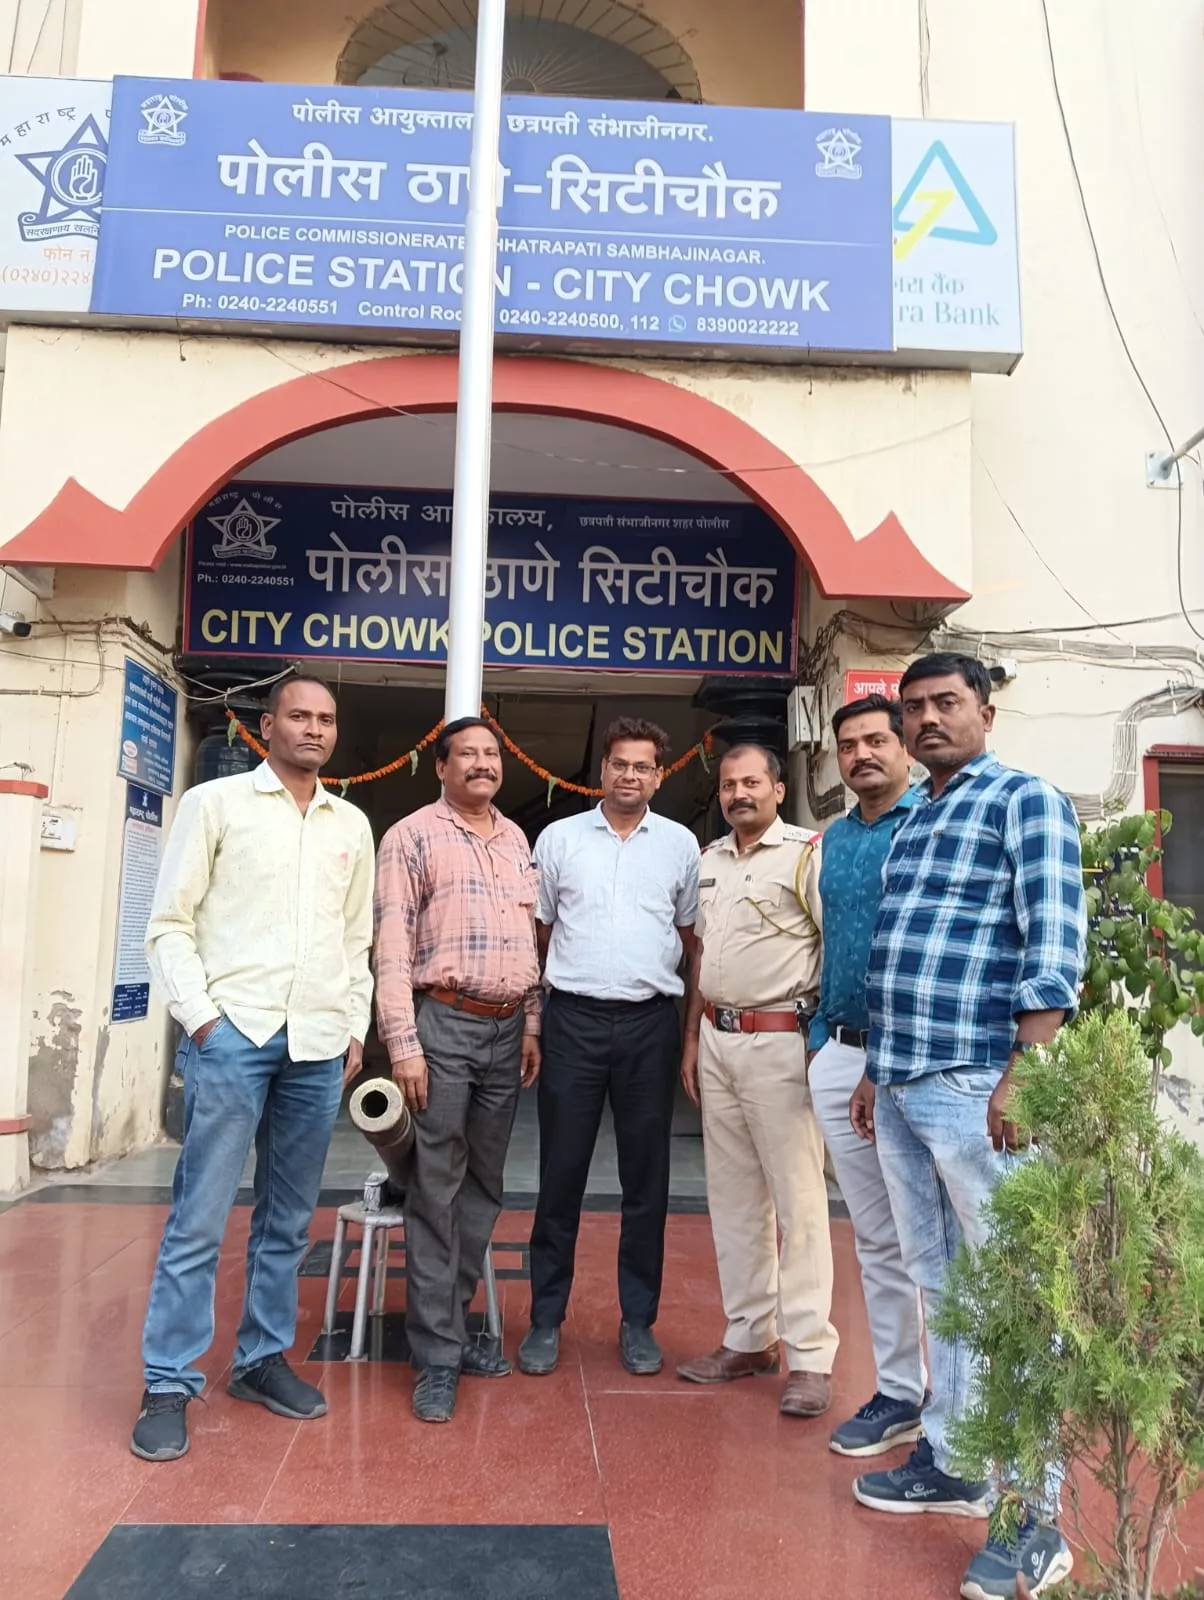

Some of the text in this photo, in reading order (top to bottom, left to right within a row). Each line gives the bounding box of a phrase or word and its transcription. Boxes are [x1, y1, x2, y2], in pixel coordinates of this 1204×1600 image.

[292, 98, 714, 142] पोलीस आयुक्ताल छत्रपती संभाजीनगर.
[217, 138, 388, 202] पोलीस
[406, 160, 511, 207] ठा
[546, 153, 782, 220] सिटीचौक
[224, 224, 766, 265] POLICE COMMISSIONERATE HHATRAPATI SAMBHAJINAGAR.
[152, 248, 315, 287] POLICE
[553, 267, 652, 303] CITY
[663, 273, 831, 312] CHOWK
[182, 294, 799, 336] Ph: 0240-2240551 Control Roo 0240-2240500, 112 8390022222
[935, 301, 1001, 326] Bank
[330, 494, 410, 522] पोलीस
[221, 574, 295, 586] 0240-2240551
[305, 531, 450, 597] पोलीस
[578, 545, 777, 608] सिटीचौक
[201, 609, 292, 646] CITY
[303, 613, 448, 652] CHOWK
[622, 626, 783, 665] STATION
